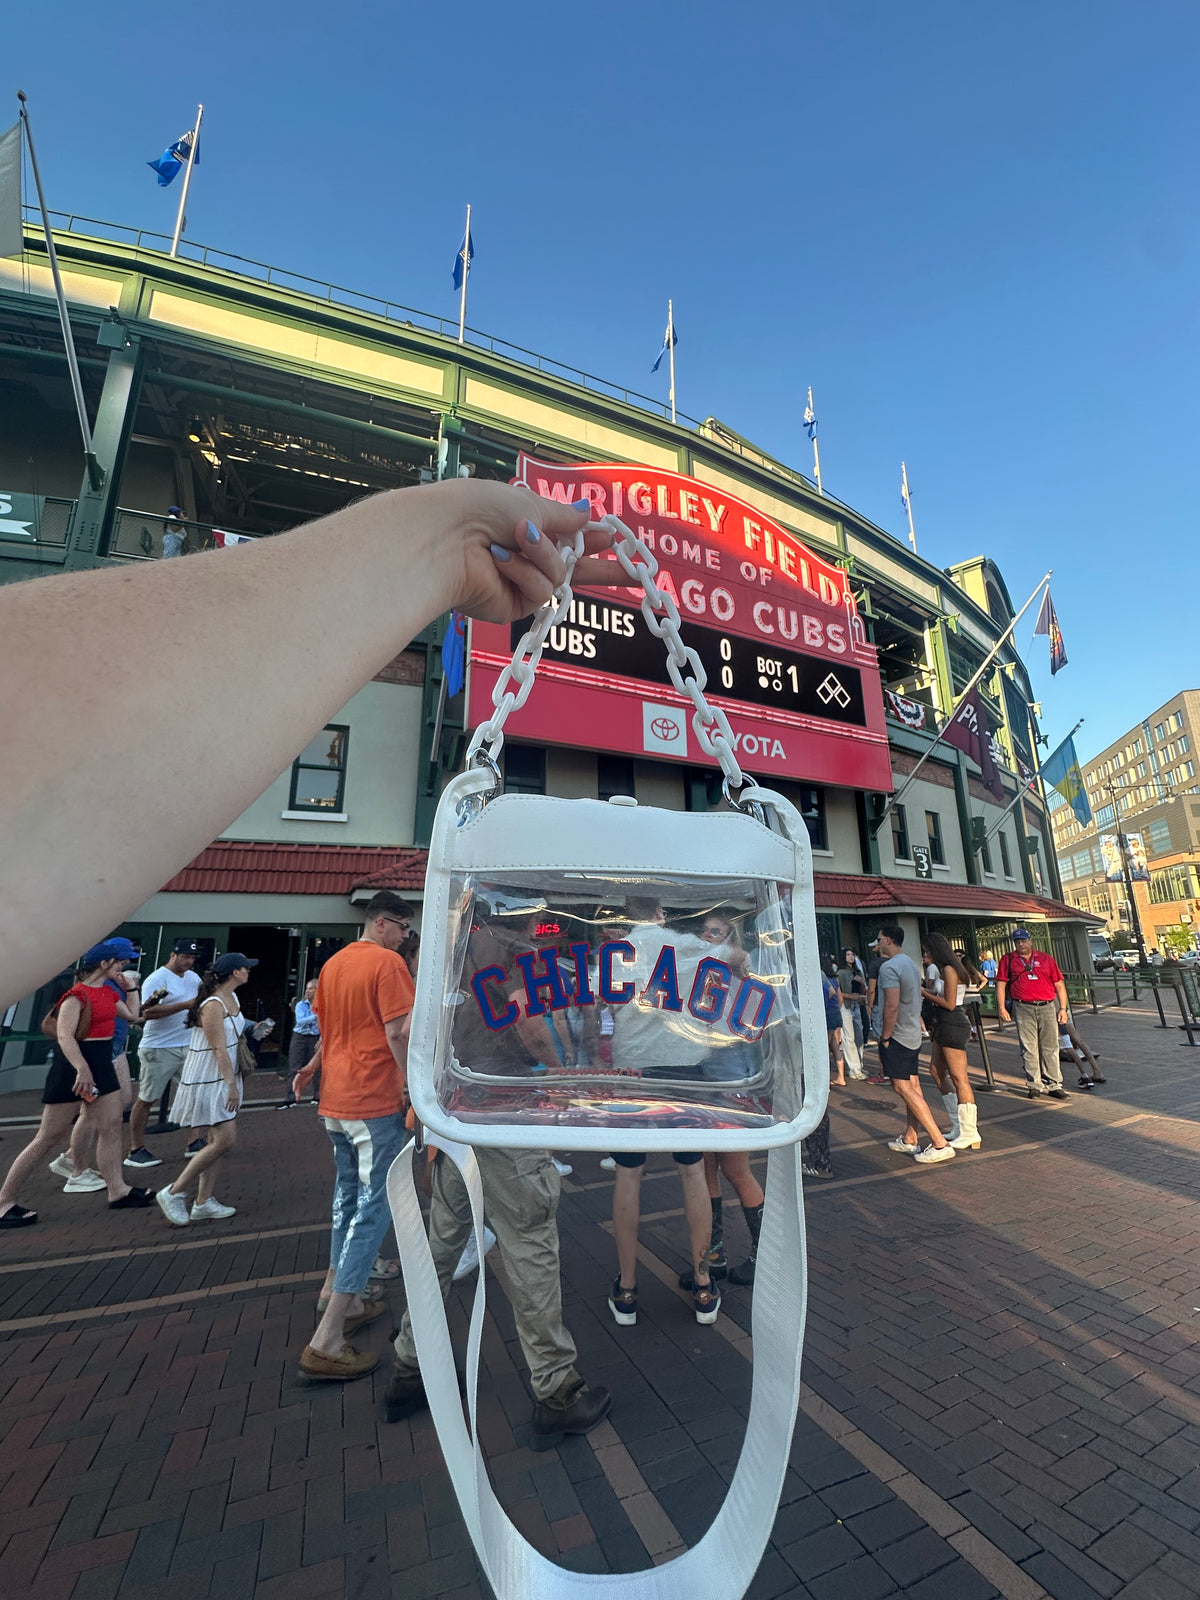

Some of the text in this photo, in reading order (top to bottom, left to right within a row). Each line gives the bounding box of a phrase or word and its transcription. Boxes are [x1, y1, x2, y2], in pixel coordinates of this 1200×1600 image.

[536, 478, 728, 533] WRIGLEY
[743, 516, 843, 607] FIELD
[637, 525, 773, 586] HOME OF
[720, 638, 732, 661] 0
[752, 601, 848, 654] CUBS
[542, 625, 734, 689] UBS 0
[756, 656, 799, 694] BOT 1
[913, 846, 928, 855] GATE
[916, 853, 929, 872] 3
[470, 939, 776, 1043] CHICAGO
